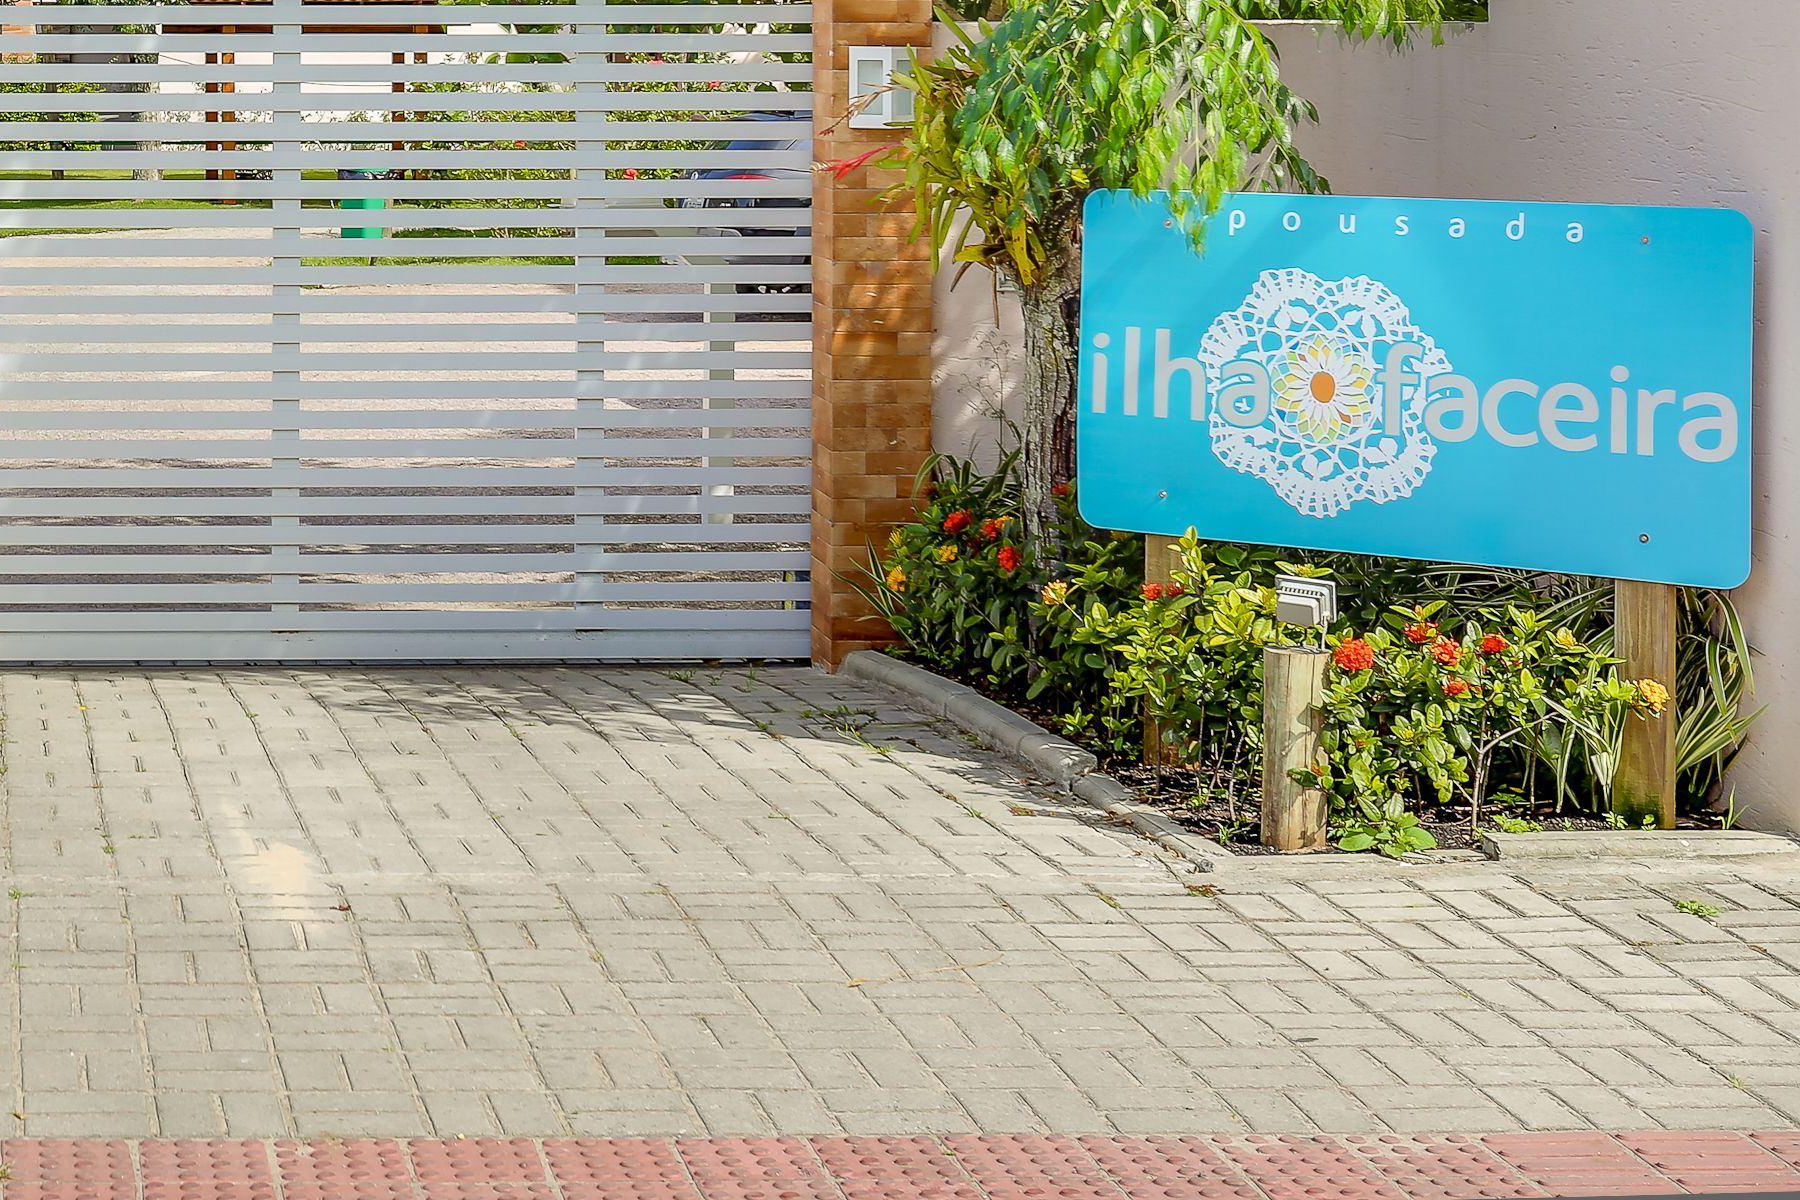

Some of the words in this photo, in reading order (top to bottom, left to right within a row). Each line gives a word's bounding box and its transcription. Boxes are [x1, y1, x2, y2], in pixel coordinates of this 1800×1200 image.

[1228, 209, 1585, 243] pousada
[1091, 326, 1271, 427] ilha
[1377, 342, 1739, 463] faceira
